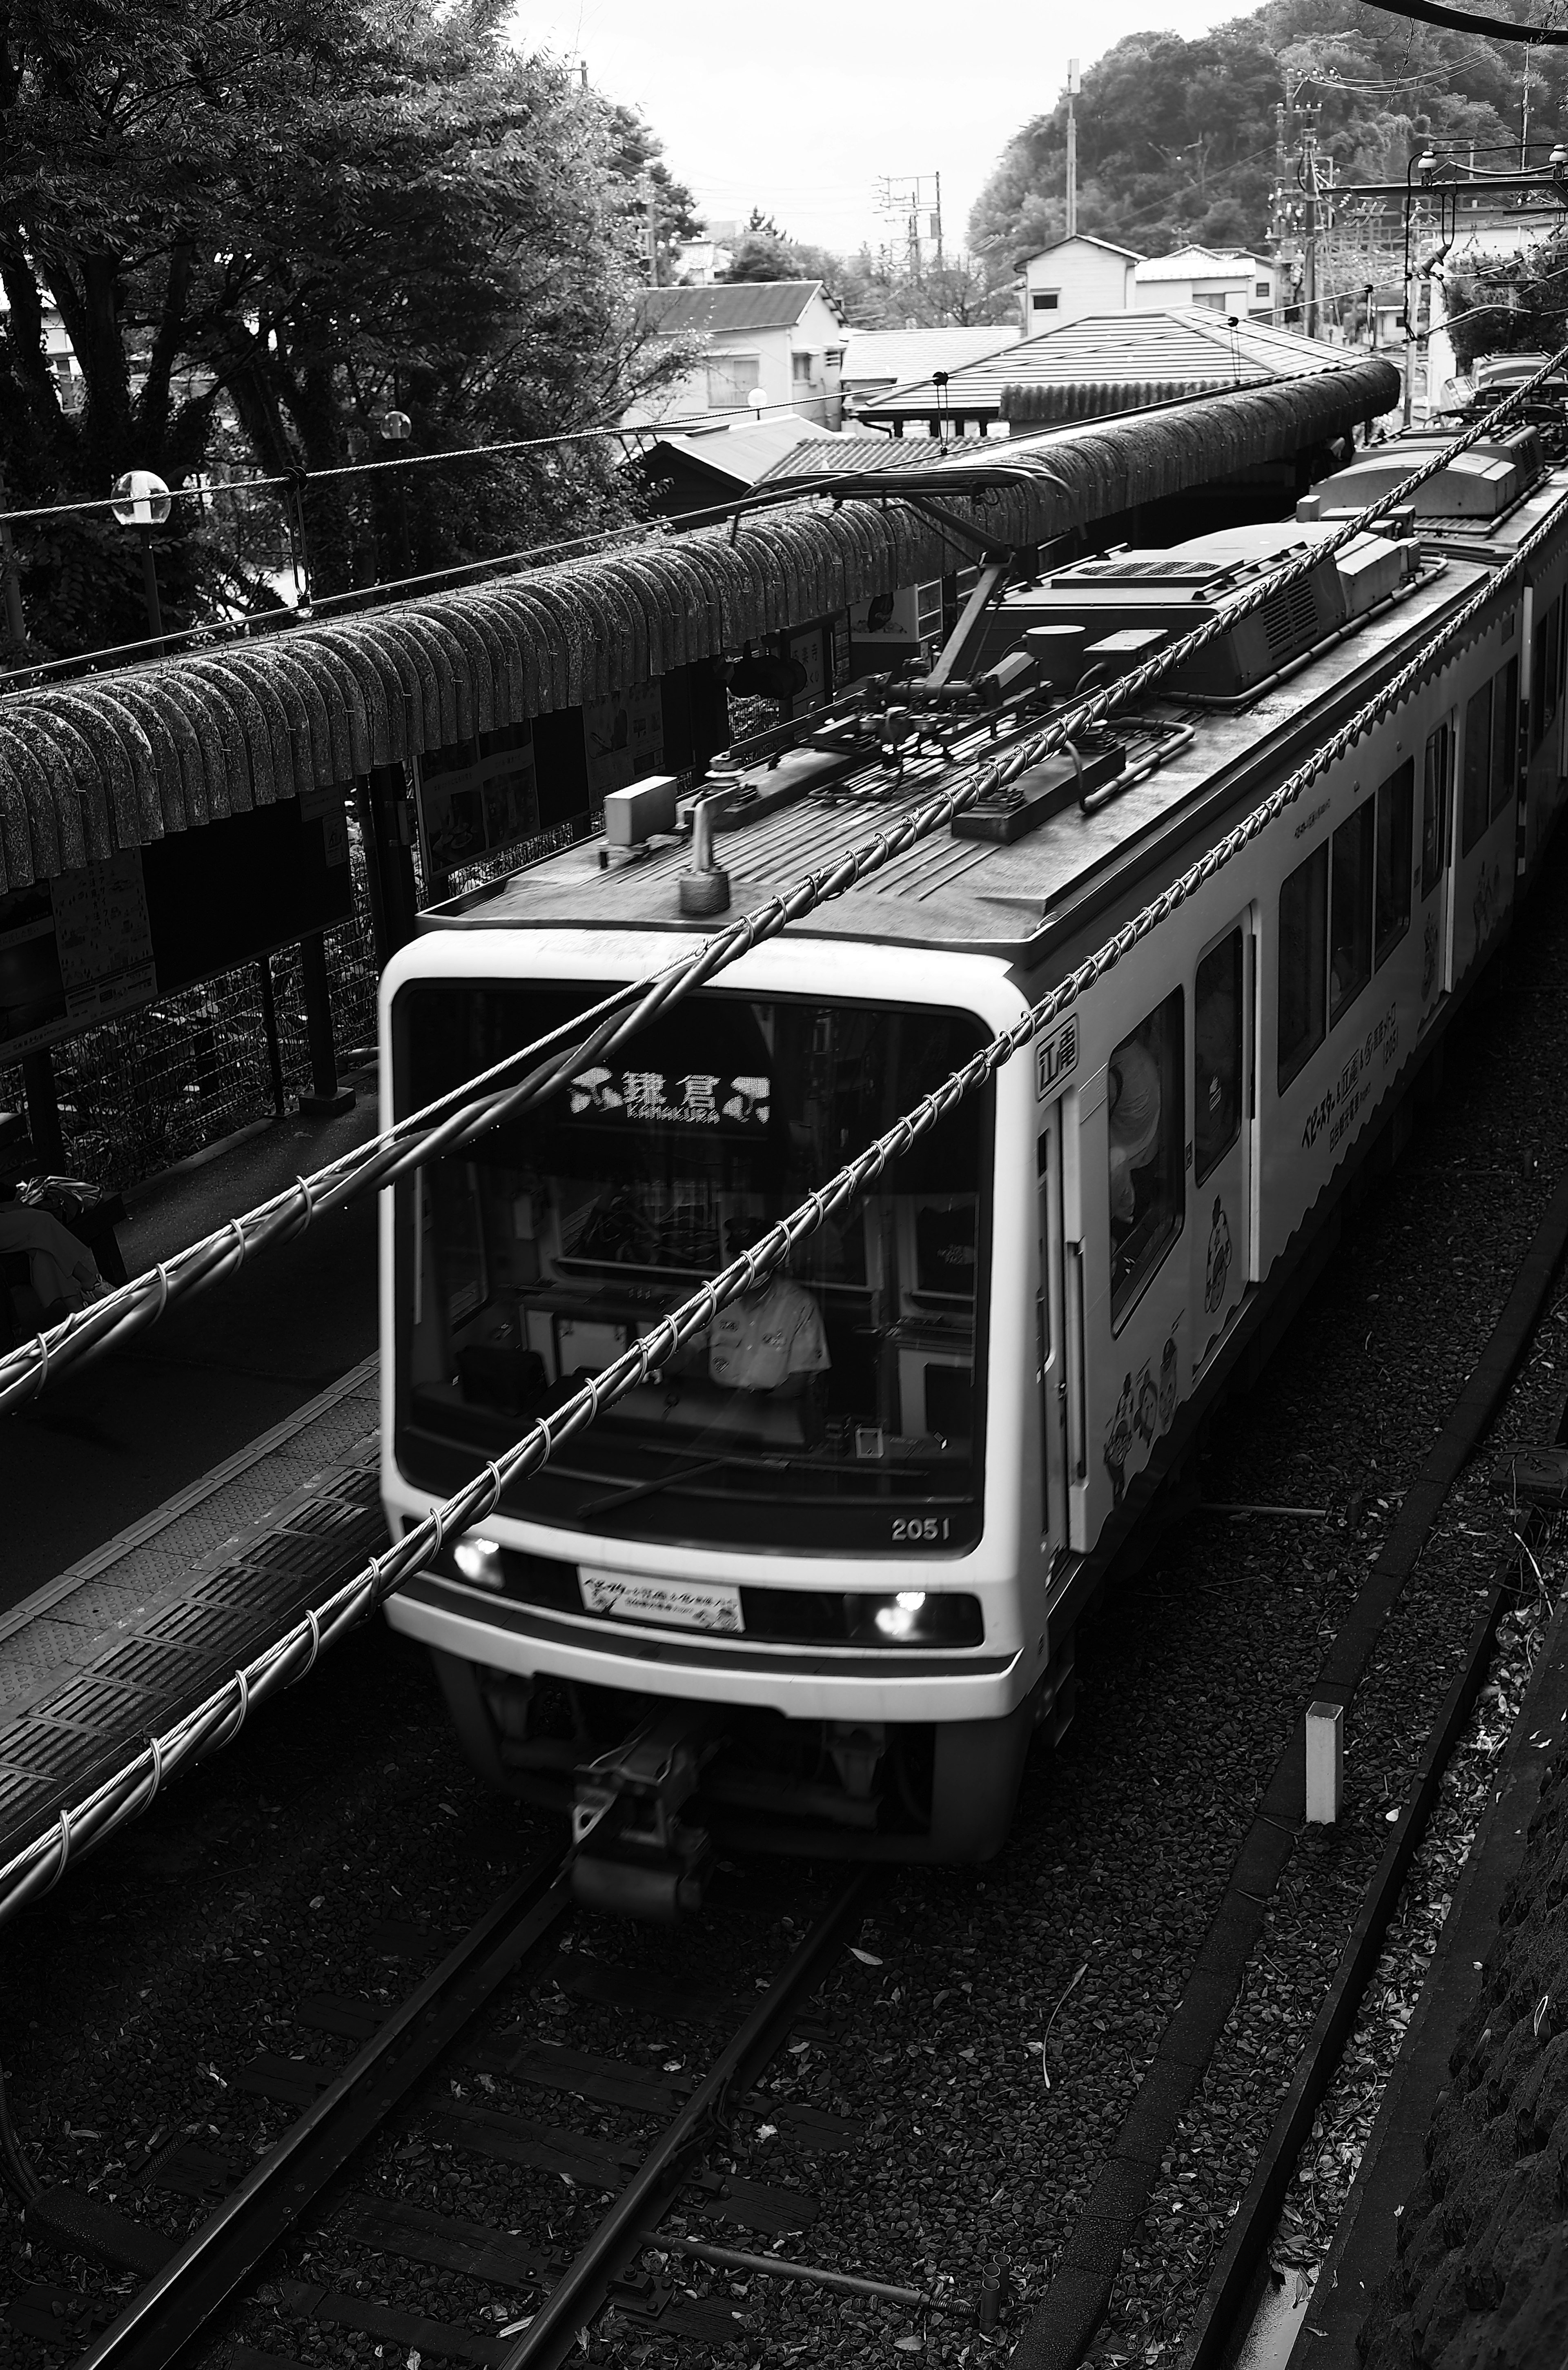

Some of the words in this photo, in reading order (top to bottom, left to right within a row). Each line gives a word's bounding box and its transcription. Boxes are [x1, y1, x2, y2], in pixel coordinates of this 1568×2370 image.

[98, 860, 111, 929] ェアサイクル、
[891, 1517, 951, 1541] 2051
